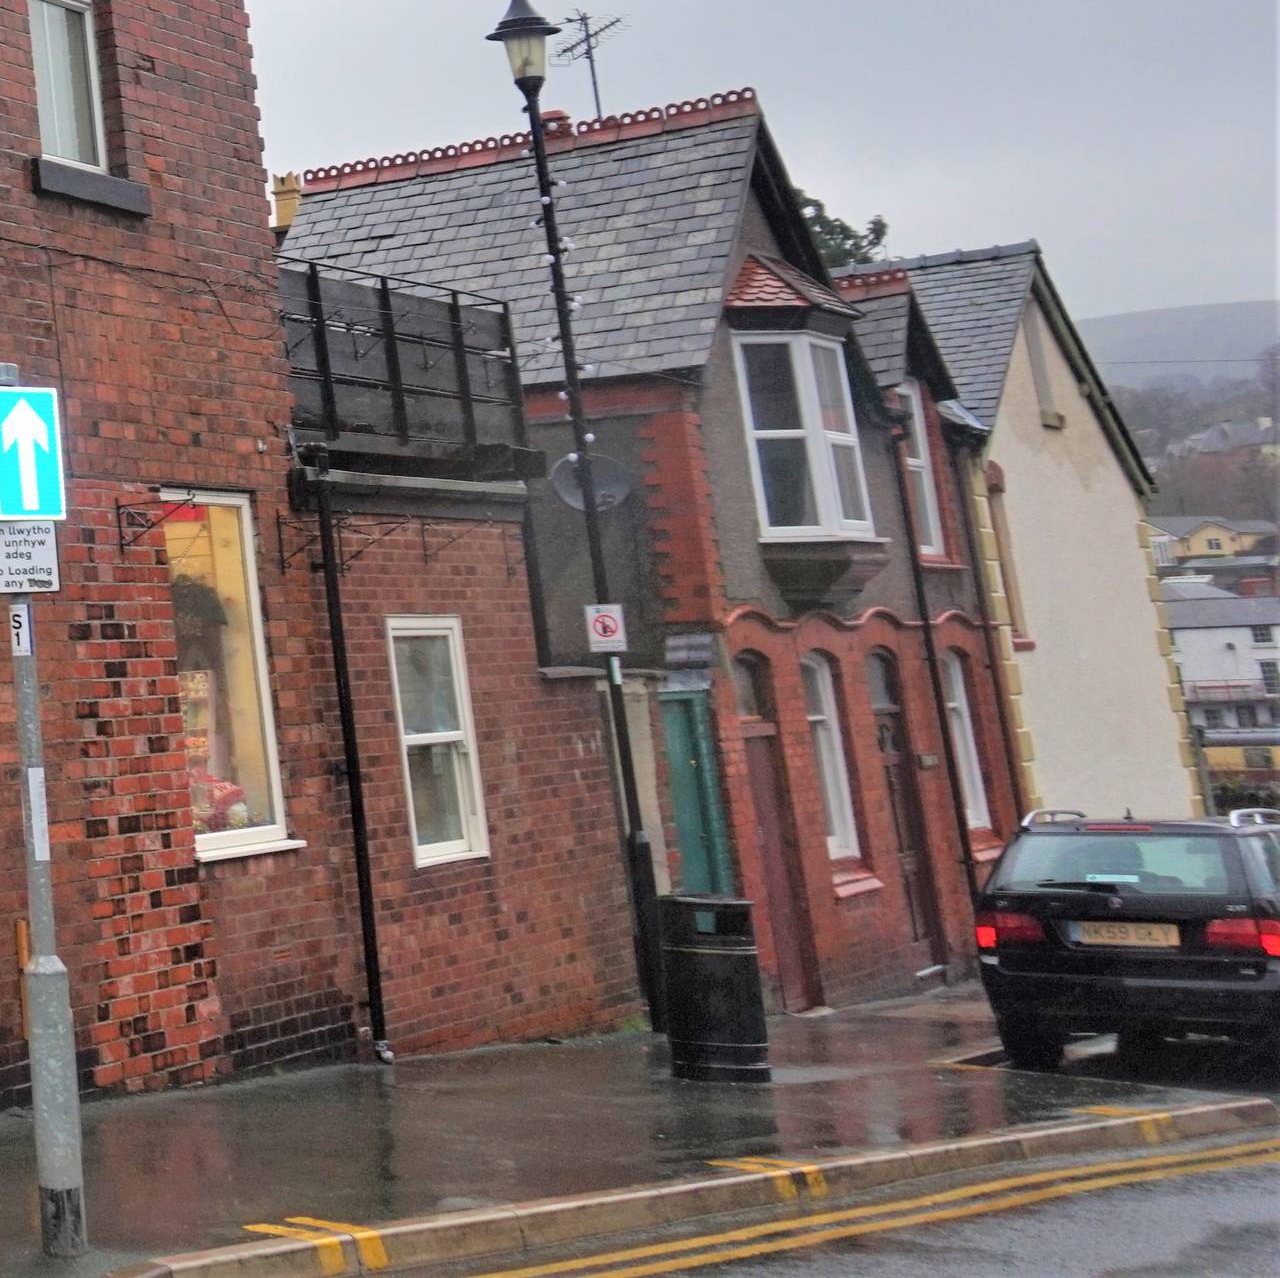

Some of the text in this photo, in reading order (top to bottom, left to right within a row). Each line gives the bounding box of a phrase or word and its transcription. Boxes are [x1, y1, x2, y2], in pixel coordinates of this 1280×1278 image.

[8, 525, 51, 539] llwytho
[4, 538, 46, 549] unrhyw
[5, 550, 32, 561] adeg
[8, 566, 53, 577] Loading
[4, 580, 25, 590] any
[11, 613, 23, 630] S
[14, 631, 21, 647] 1
